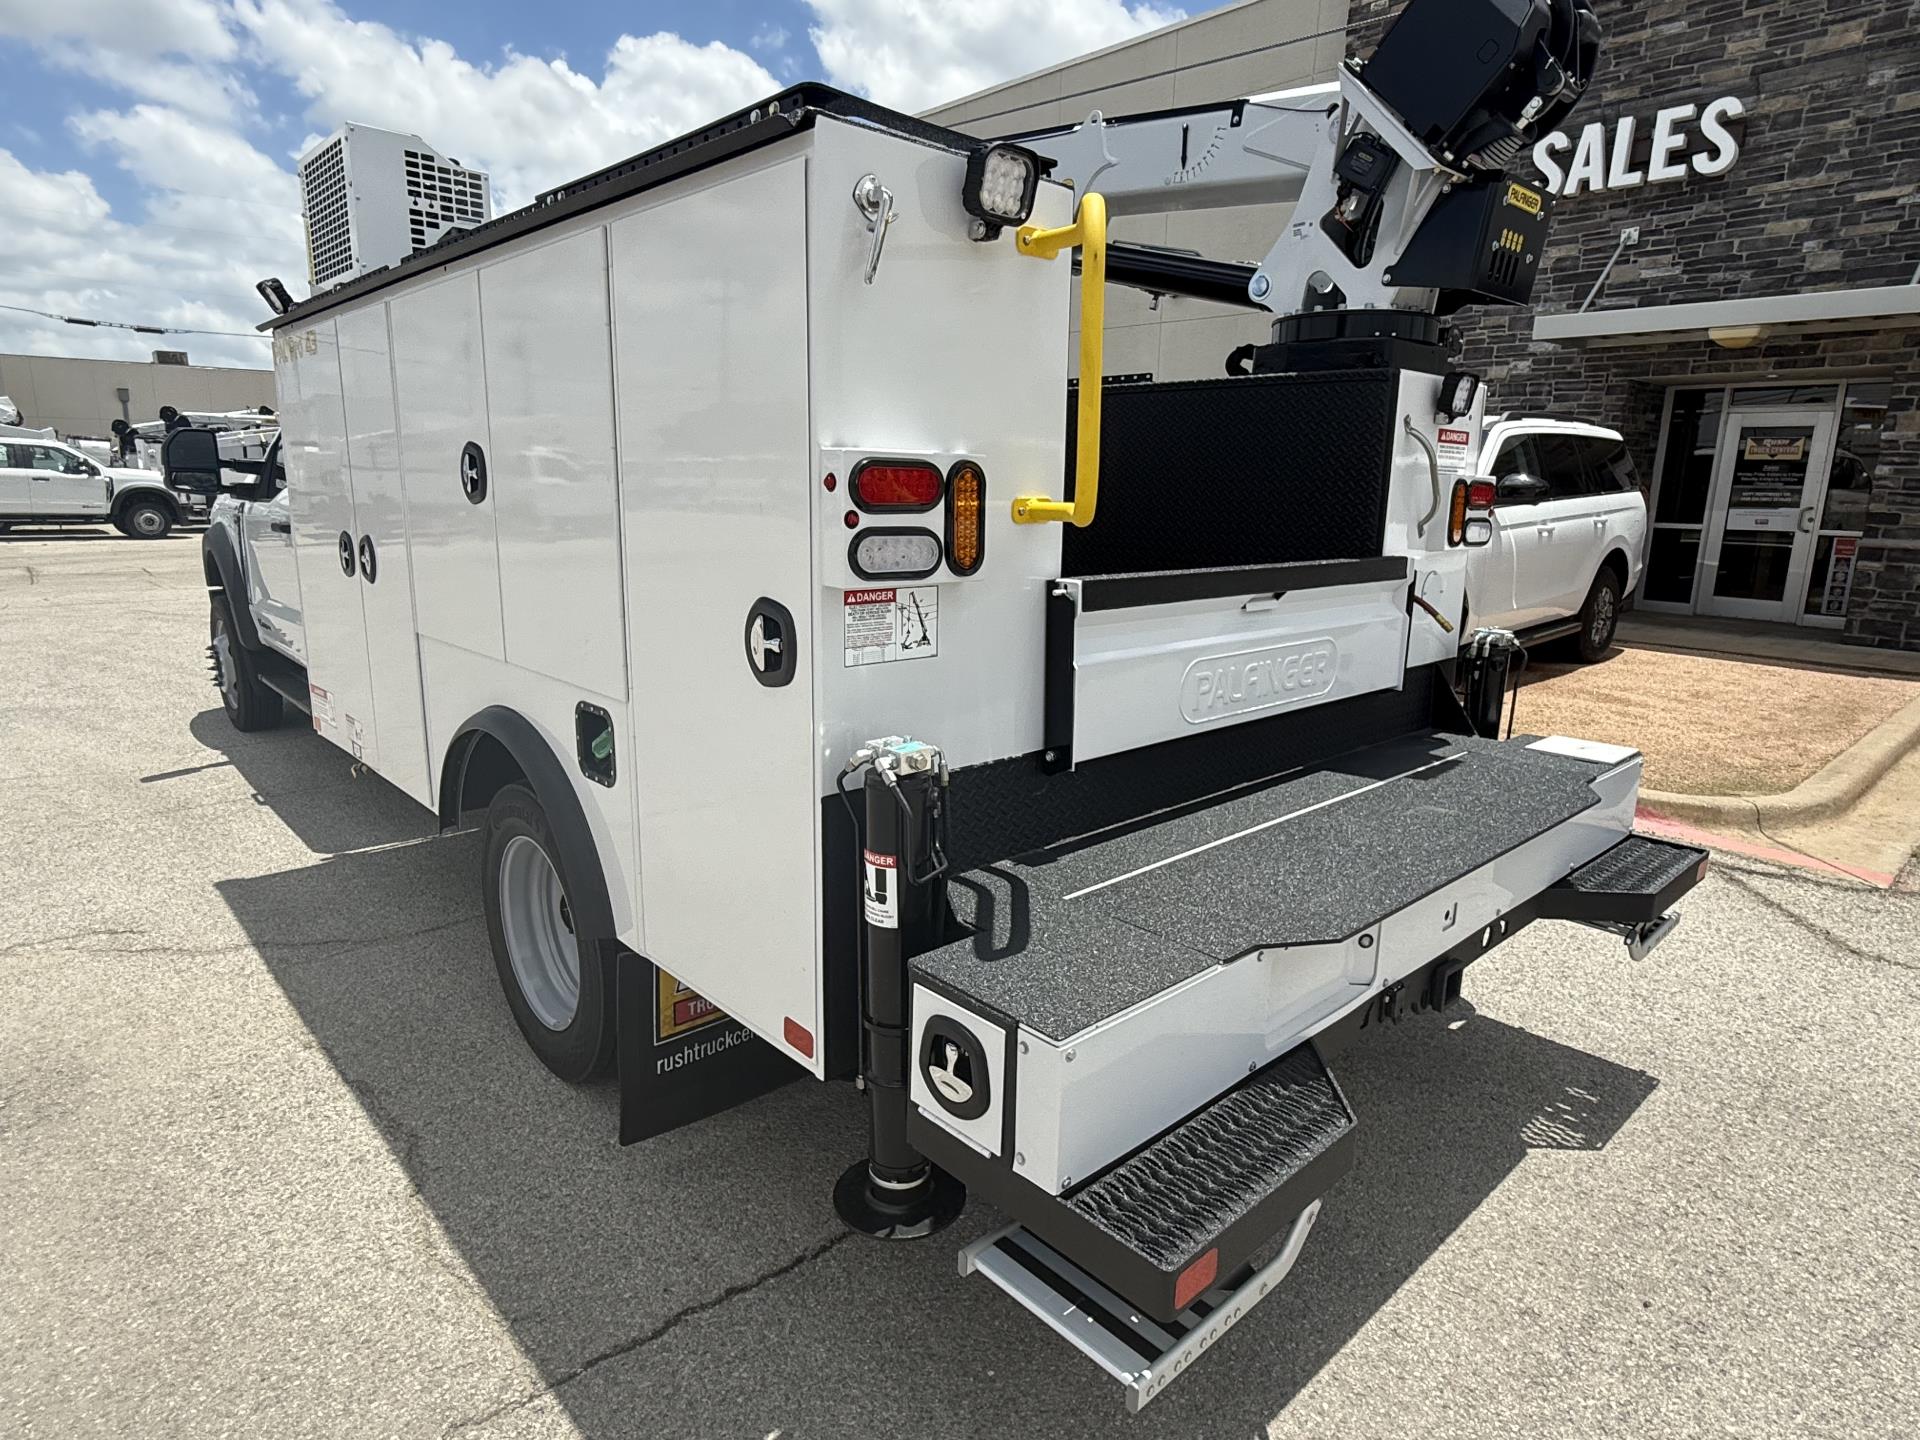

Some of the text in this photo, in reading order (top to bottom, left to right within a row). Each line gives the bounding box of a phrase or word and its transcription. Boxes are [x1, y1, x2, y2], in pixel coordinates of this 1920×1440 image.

[1532, 96, 1745, 197] SALES
[1510, 187, 1539, 210] PALFINGER
[1446, 431, 1467, 443] DANGER
[856, 591, 894, 602] DANGER
[1191, 648, 1330, 712] PALFINGER
[865, 850, 894, 866] ANGER
